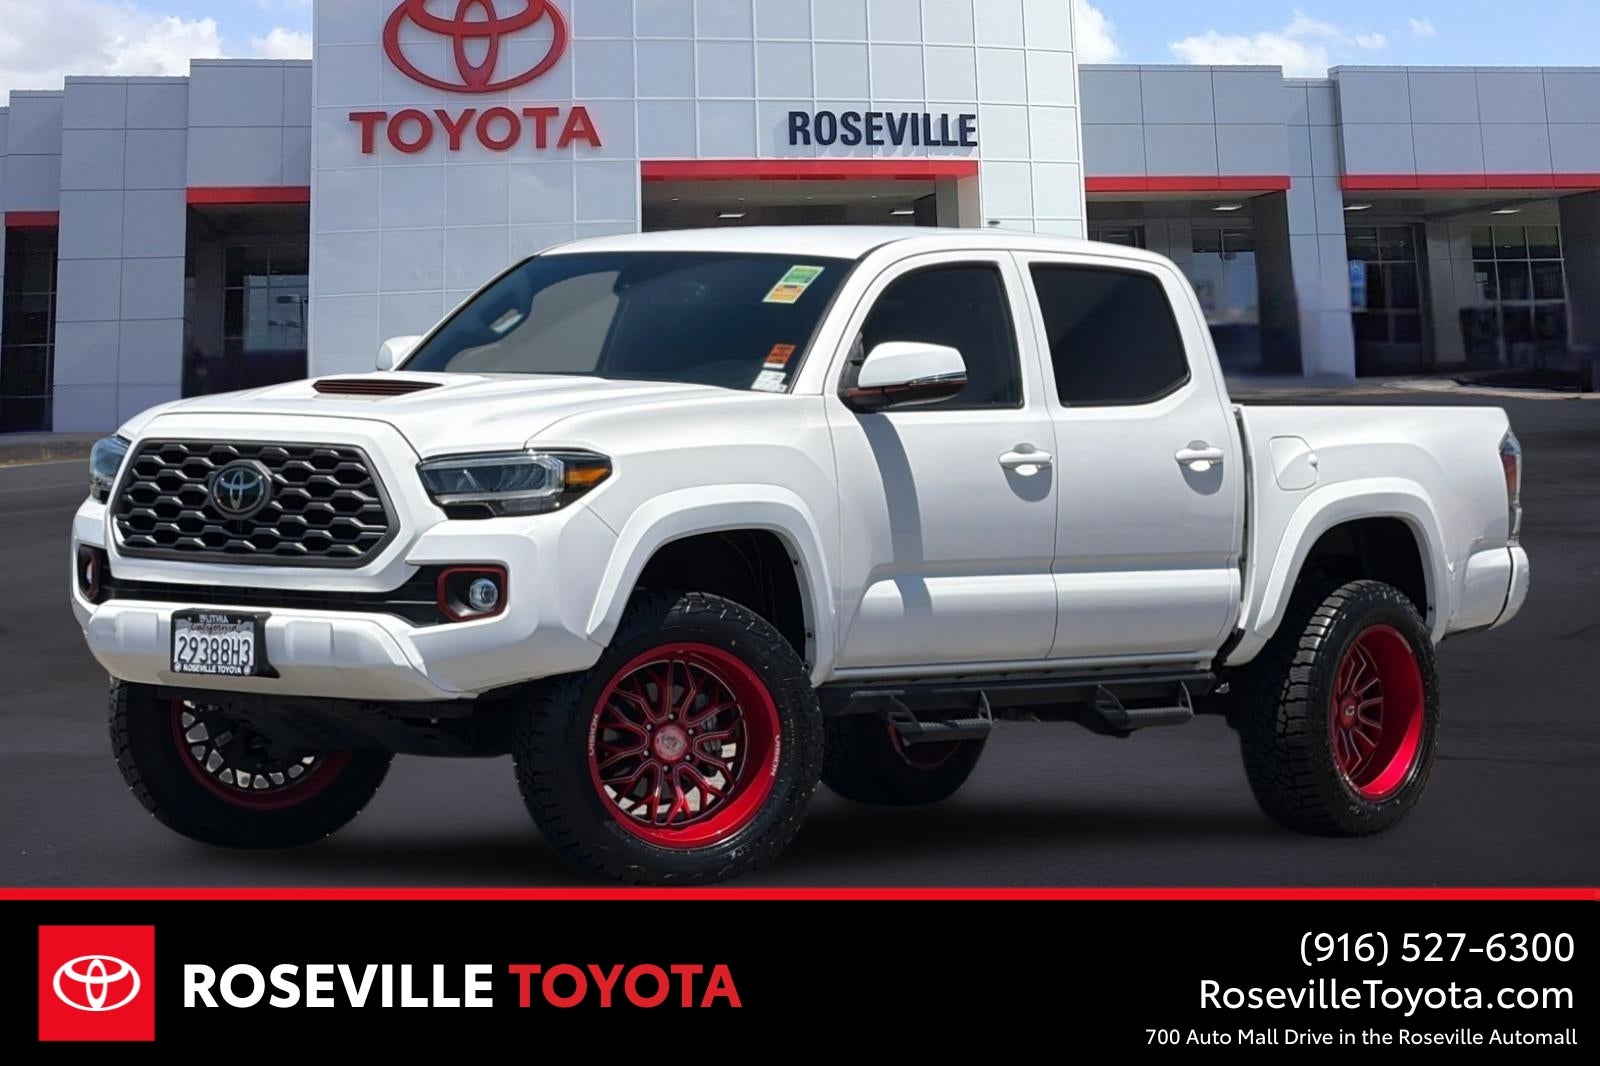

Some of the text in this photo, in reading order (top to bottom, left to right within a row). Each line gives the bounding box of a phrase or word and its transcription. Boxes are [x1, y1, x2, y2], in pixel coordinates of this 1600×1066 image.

[349, 106, 602, 154] TOYOTA
[788, 110, 978, 147] ROSEVILLE
[177, 635, 251, 666] 29388H3
[182, 663, 242, 675] ROSEVILLE TOYOTA
